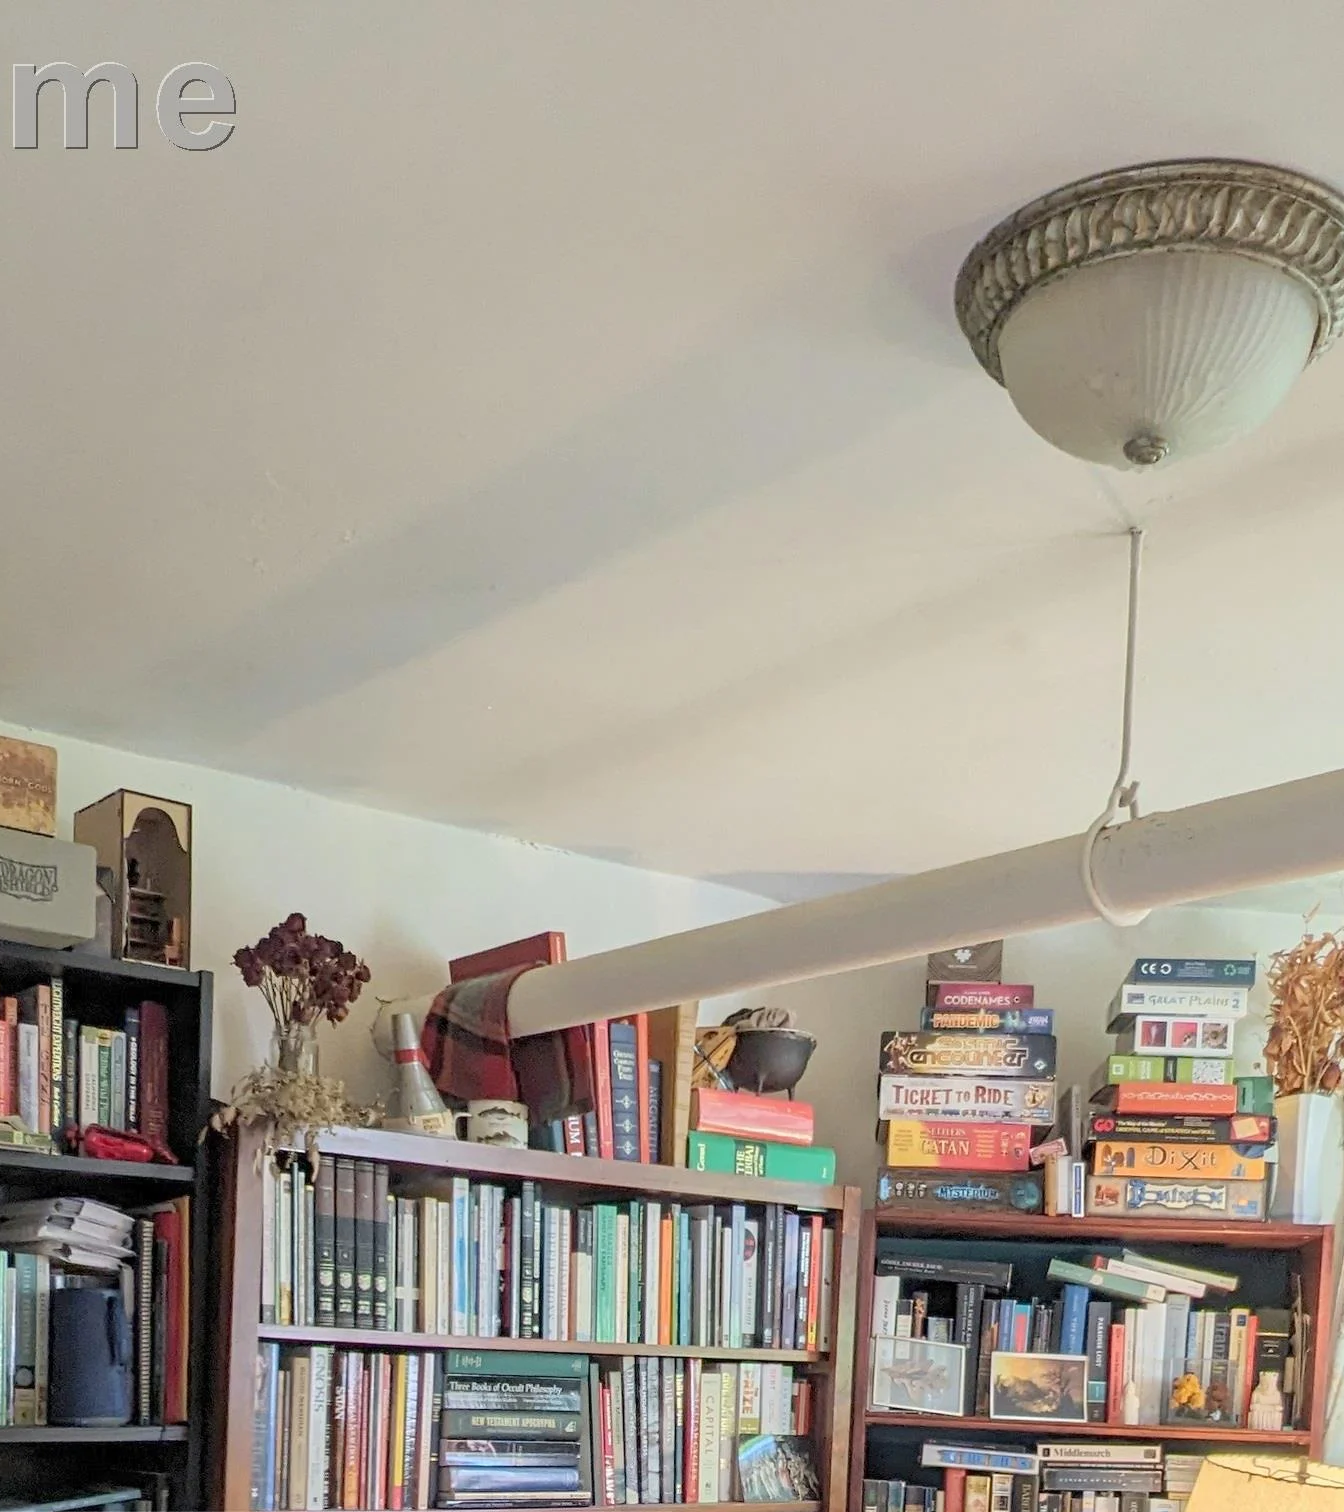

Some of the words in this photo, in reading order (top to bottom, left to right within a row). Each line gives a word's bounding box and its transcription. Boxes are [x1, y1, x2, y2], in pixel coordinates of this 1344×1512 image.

[0, 863, 56, 882] DRAGON
[944, 994, 1011, 1006] CODENAMES
[1148, 993, 1187, 1007] GREAT
[1188, 994, 1230, 1008] PLAINS
[933, 1012, 1001, 1029] PANDEMIC
[892, 1084, 954, 1106] TICKET
[974, 1086, 1014, 1107] RIDE
[920, 1138, 970, 1156] CATAN
[735, 1149, 746, 1176] THE
[937, 1183, 1000, 1201] MYSTERIUM
[1097, 1316, 1105, 1350] PARADISE
[1095, 1351, 1103, 1368] LOST
[313, 1354, 326, 1412] GNOSIS
[451, 1381, 470, 1391] Three
[741, 1370, 754, 1414] PRIZE
[334, 1385, 346, 1420] SATAN
[704, 1394, 715, 1455] CAPITAL
[1054, 1447, 1112, 1459] Middlemarch
